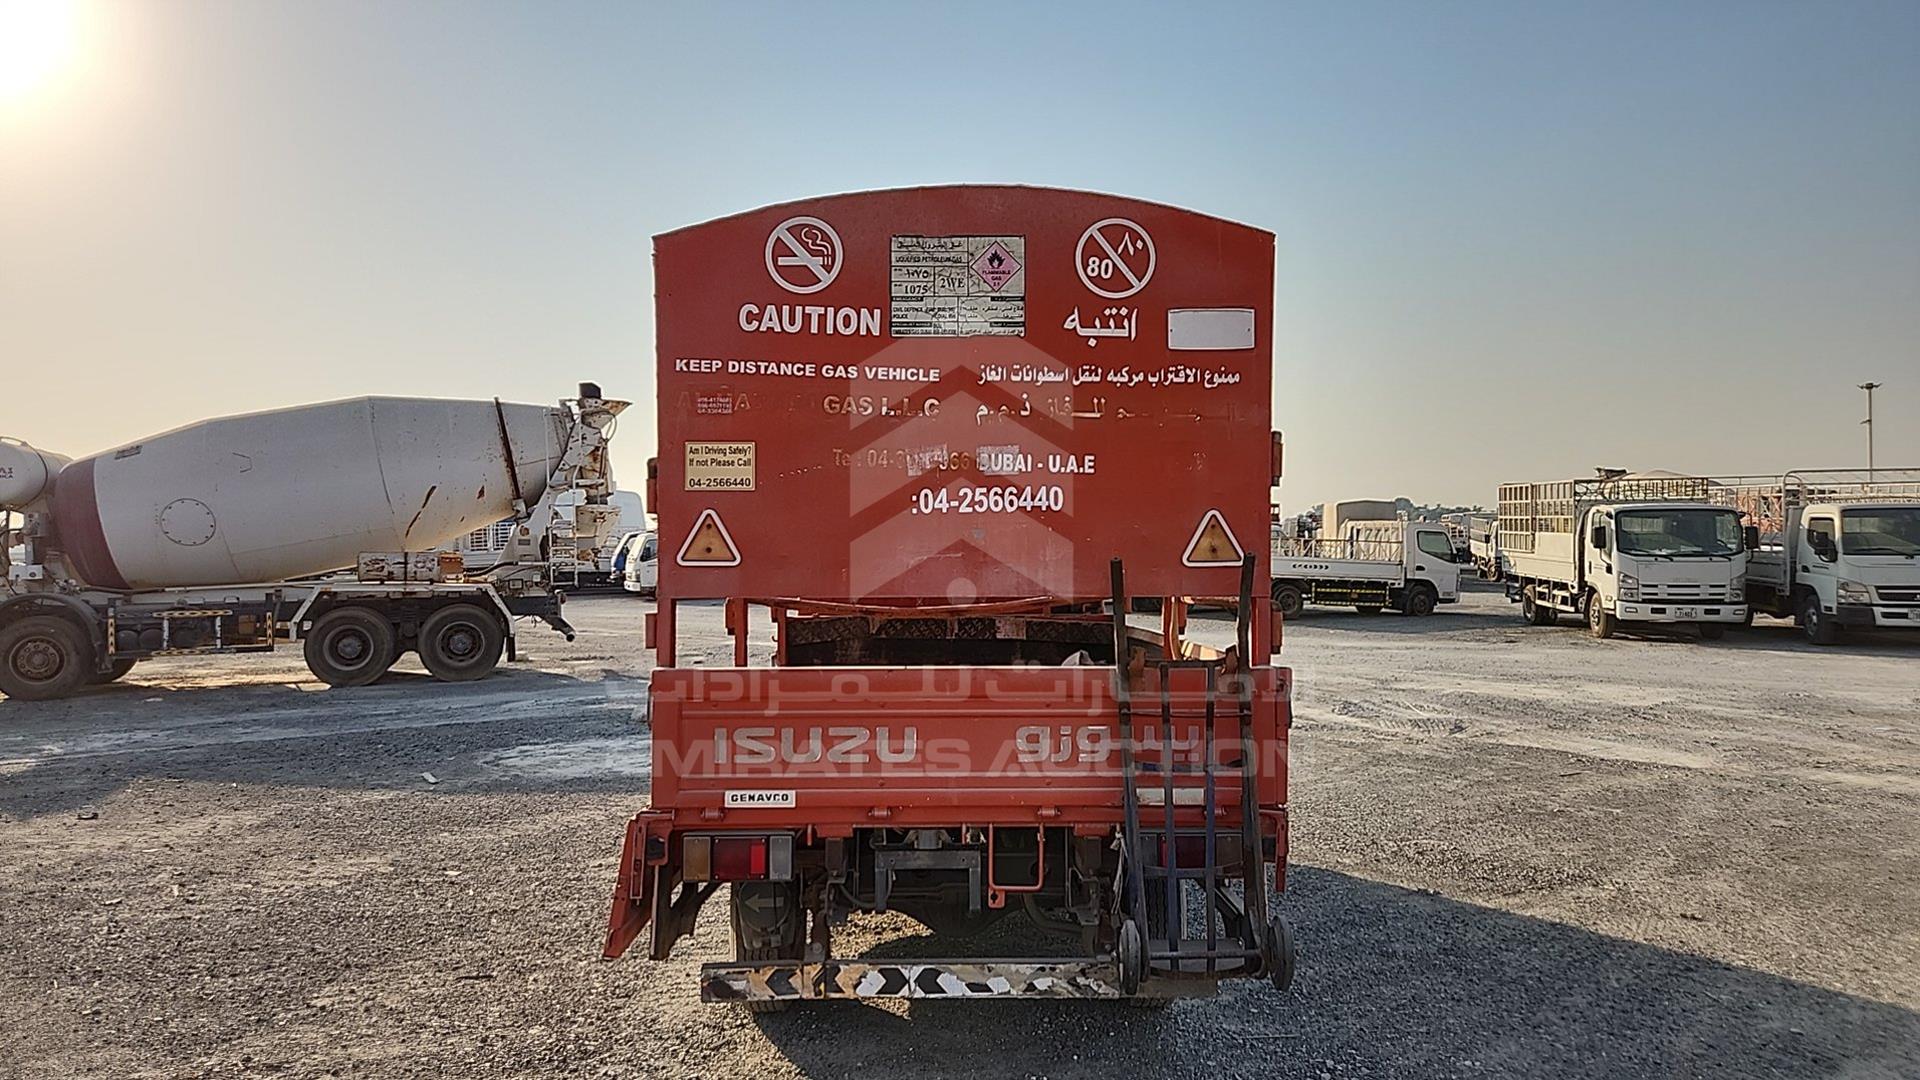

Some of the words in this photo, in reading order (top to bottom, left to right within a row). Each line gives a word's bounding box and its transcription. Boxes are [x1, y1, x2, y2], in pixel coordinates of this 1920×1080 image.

[1086, 256, 1114, 280] 80
[904, 284, 928, 295] 1075
[940, 277, 965, 289] 2WE
[738, 303, 882, 336] CAUTION
[1063, 305, 1138, 348] انتبه
[675, 359, 722, 373] KEEP
[727, 360, 816, 377] DISTANCE
[821, 364, 858, 379] GAS
[865, 366, 940, 382] VEHICLE
[977, 363, 1007, 385] الغاز
[1011, 364, 1069, 387] اسطوانات
[1073, 365, 1102, 387] لنقل
[1148, 366, 1201, 388] الاقتراب
[1204, 366, 1241, 389] ممنوع
[823, 396, 874, 416] GAS
[689, 445, 700, 455] Am
[705, 445, 727, 456] Driving
[728, 445, 751, 456] Safely?
[689, 458, 695, 467] If
[696, 458, 709, 467] not
[710, 458, 736, 467] Please
[737, 458, 751, 467] Call
[977, 453, 1033, 473] DUBAI
[1048, 455, 1096, 474] U.A.E
[689, 477, 751, 488] 04-2566440
[713, 726, 918, 765] ISUZU
[730, 792, 790, 803] GENAVCO
